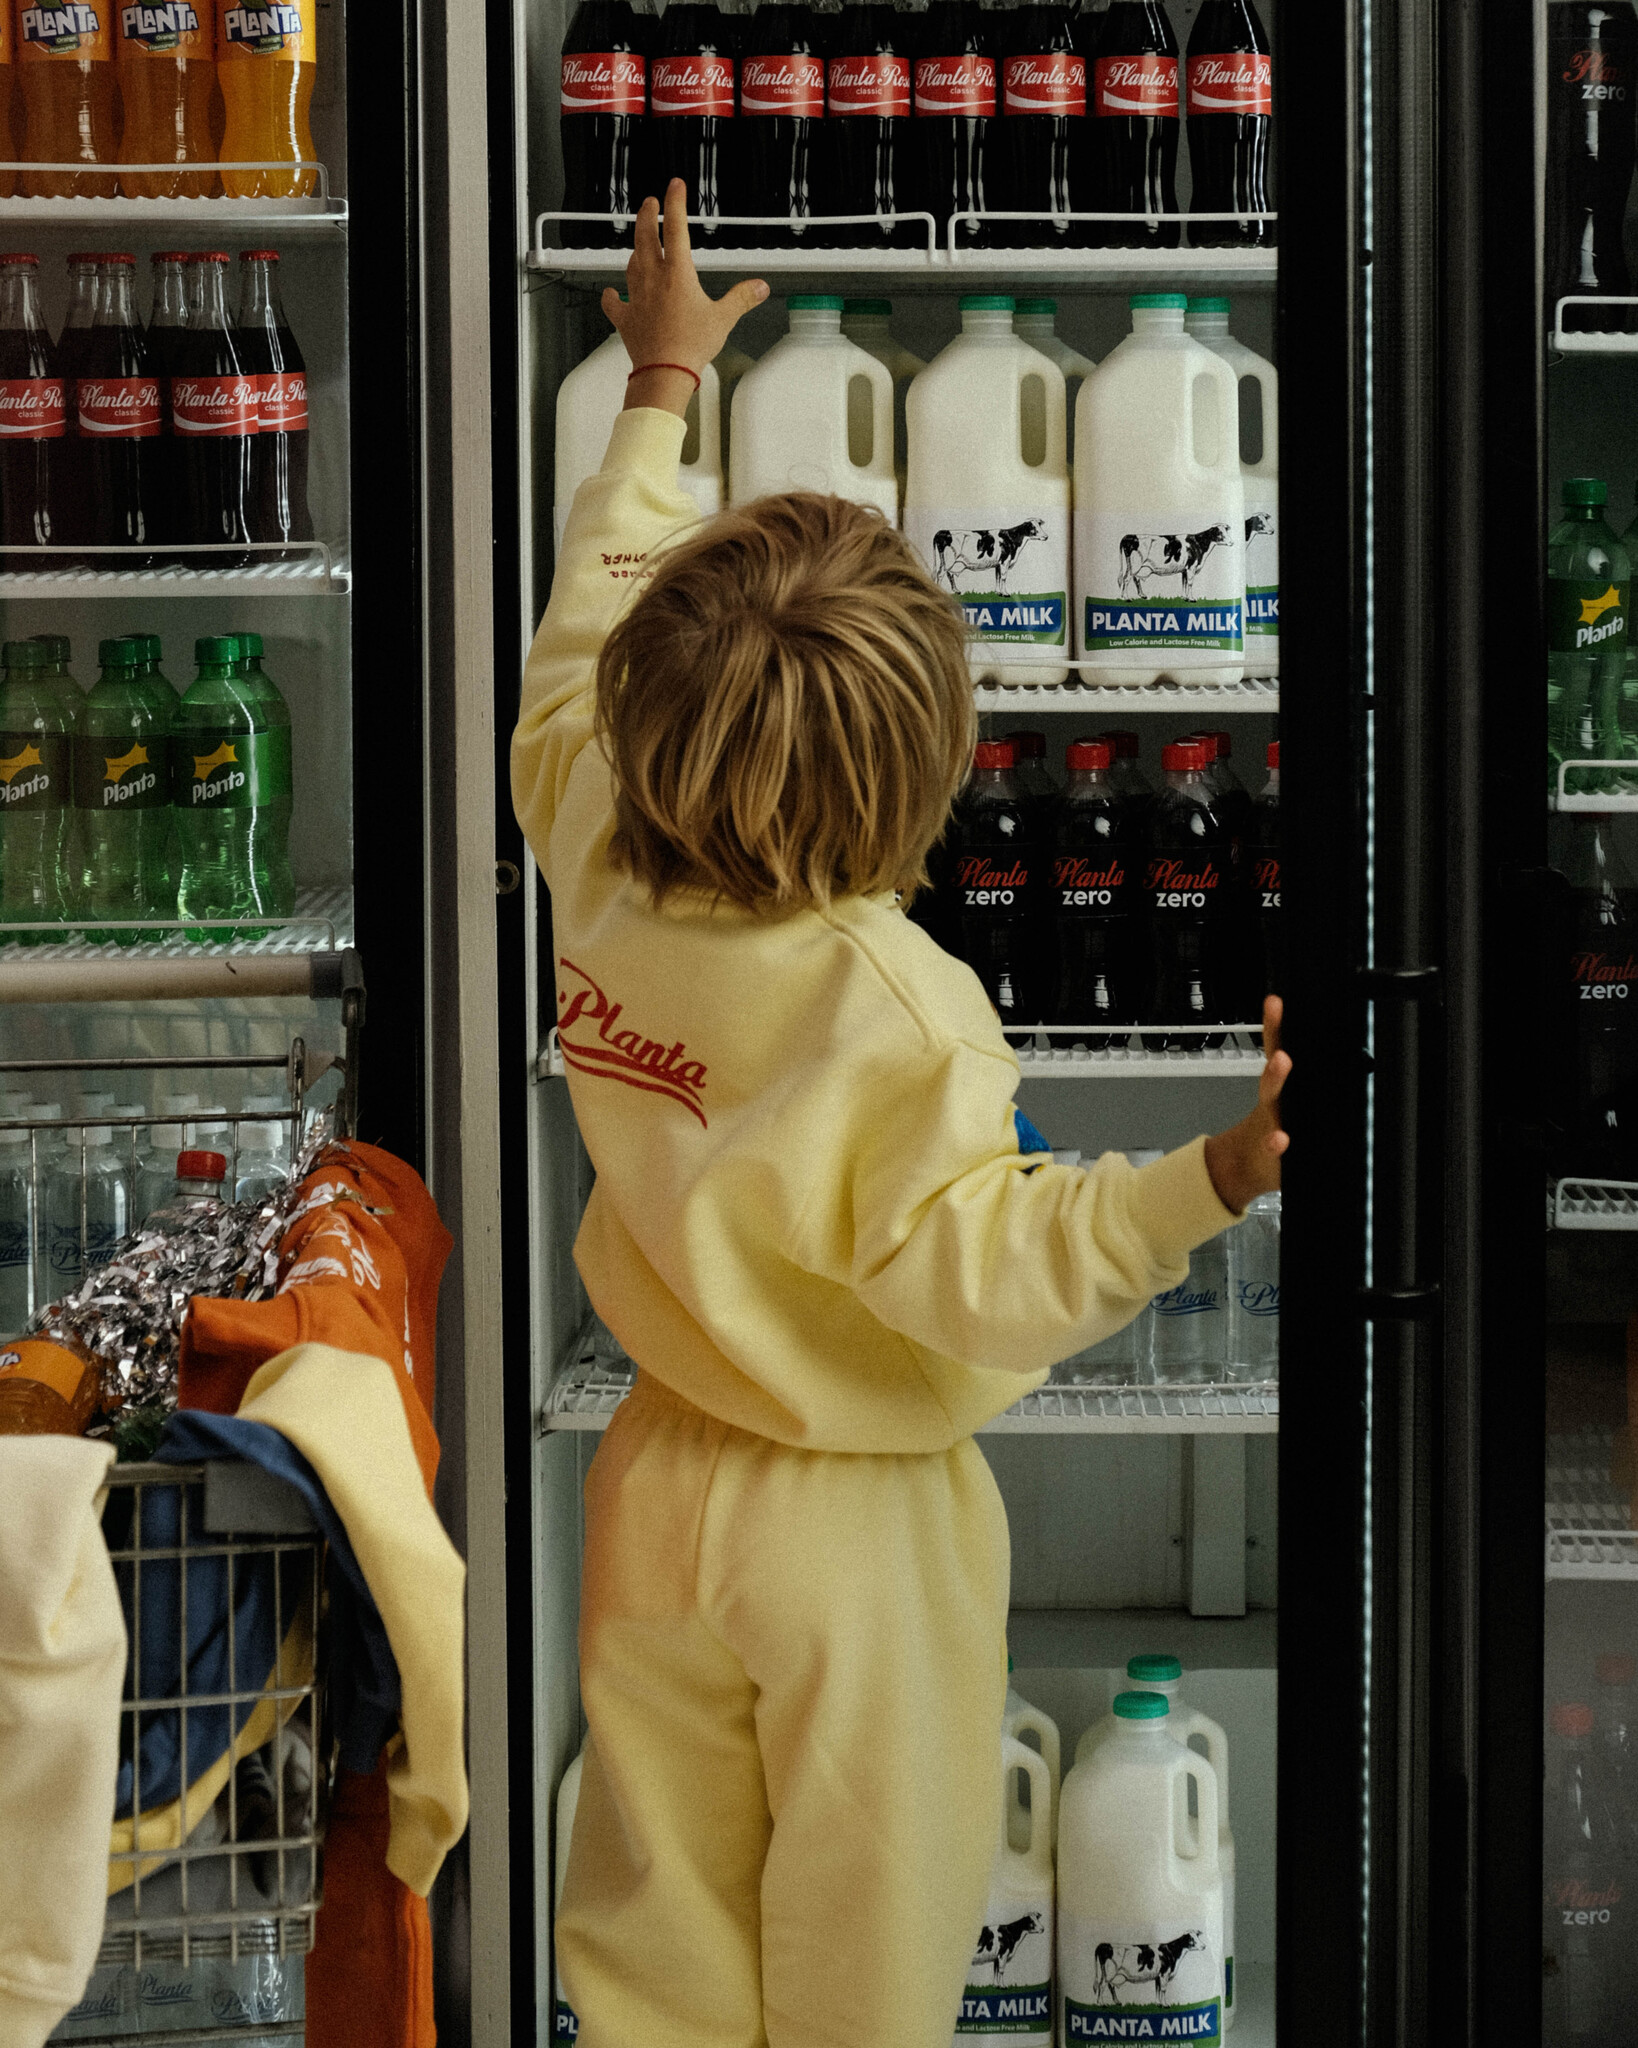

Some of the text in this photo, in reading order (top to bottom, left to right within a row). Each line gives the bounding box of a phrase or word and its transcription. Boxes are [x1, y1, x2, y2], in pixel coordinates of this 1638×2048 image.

[21, 5, 99, 40] PLANTA
[122, 3, 199, 38] PLANTA
[224, 5, 302, 41] PLANTA
[562, 60, 611, 87] Planta
[652, 64, 700, 89] Planta
[742, 62, 794, 88] Planta
[829, 64, 876, 90] Planta
[916, 63, 970, 89] Planta
[1007, 61, 1066, 87] Planta
[1105, 62, 1165, 88] Planta
[1193, 60, 1252, 86] Planta
[590, 83, 617, 92] classic
[679, 87, 706, 95] classic
[773, 86, 800, 95] classic
[856, 87, 883, 95] classic
[950, 86, 976, 95] classic
[1046, 86, 1071, 94] classic
[1147, 87, 1169, 96] classic
[1233, 85, 1258, 93] classic
[1581, 84, 1626, 100] zero
[79, 384, 135, 409] Planta
[174, 383, 229, 408] Planta
[18, 410, 45, 418] classic
[114, 408, 141, 417] classic
[209, 407, 235, 416] classic
[264, 403, 290, 412] classic
[1000, 606, 1054, 626] MILK
[1092, 612, 1239, 632] PLANTA MILK
[978, 633, 1004, 641] Lactose
[1005, 633, 1020, 641] Free
[1109, 637, 1221, 648] Low Calorie and Lactose Free Milk
[1576, 615, 1624, 649] Planta
[103, 772, 156, 806] Planta
[192, 770, 245, 805] Planta
[952, 856, 1028, 888] Planta
[1049, 856, 1124, 888] Planta
[1144, 858, 1219, 890] Planta
[965, 889, 1015, 906] zero
[1062, 889, 1112, 906] zero
[1156, 891, 1206, 908] zero
[1579, 983, 1629, 1000] zero
[557, 957, 709, 1089] Planta
[1562, 1908, 1611, 1926] zero
[997, 1995, 1049, 2018] MILK
[1071, 2012, 1212, 2037] PLANTA MILK
